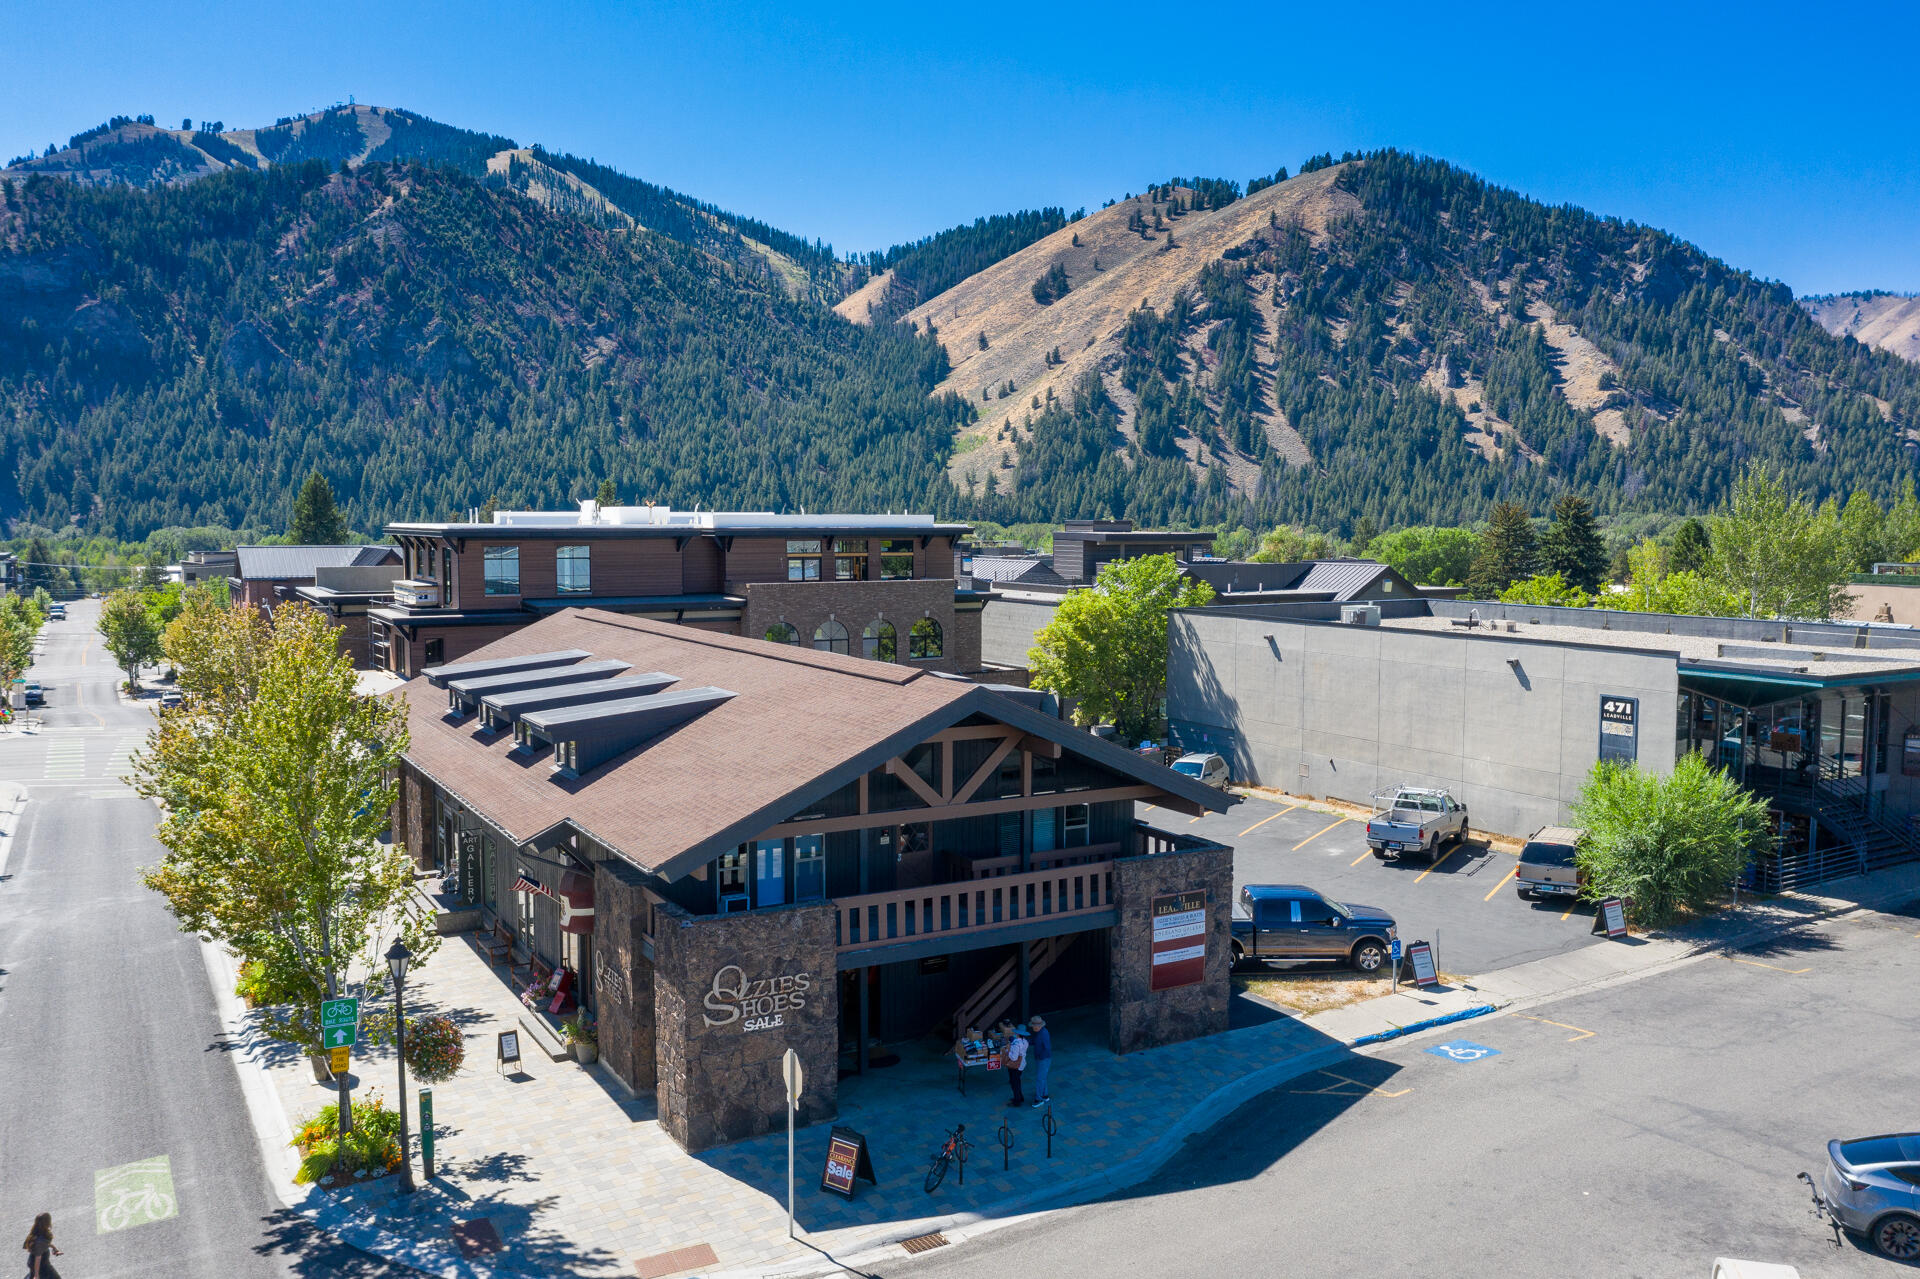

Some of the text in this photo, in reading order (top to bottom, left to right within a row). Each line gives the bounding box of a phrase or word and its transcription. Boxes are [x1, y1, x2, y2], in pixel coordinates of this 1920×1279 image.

[1603, 712, 1632, 720] LEADVILLE
[1604, 701, 1631, 714] 471
[466, 845, 475, 904] GALLERY
[1158, 901, 1201, 914] LEAILLE
[712, 965, 810, 1002] OZZIES
[703, 988, 806, 1028] SHOES
[743, 1014, 784, 1032] SALE
[826, 1160, 853, 1181] Sale
